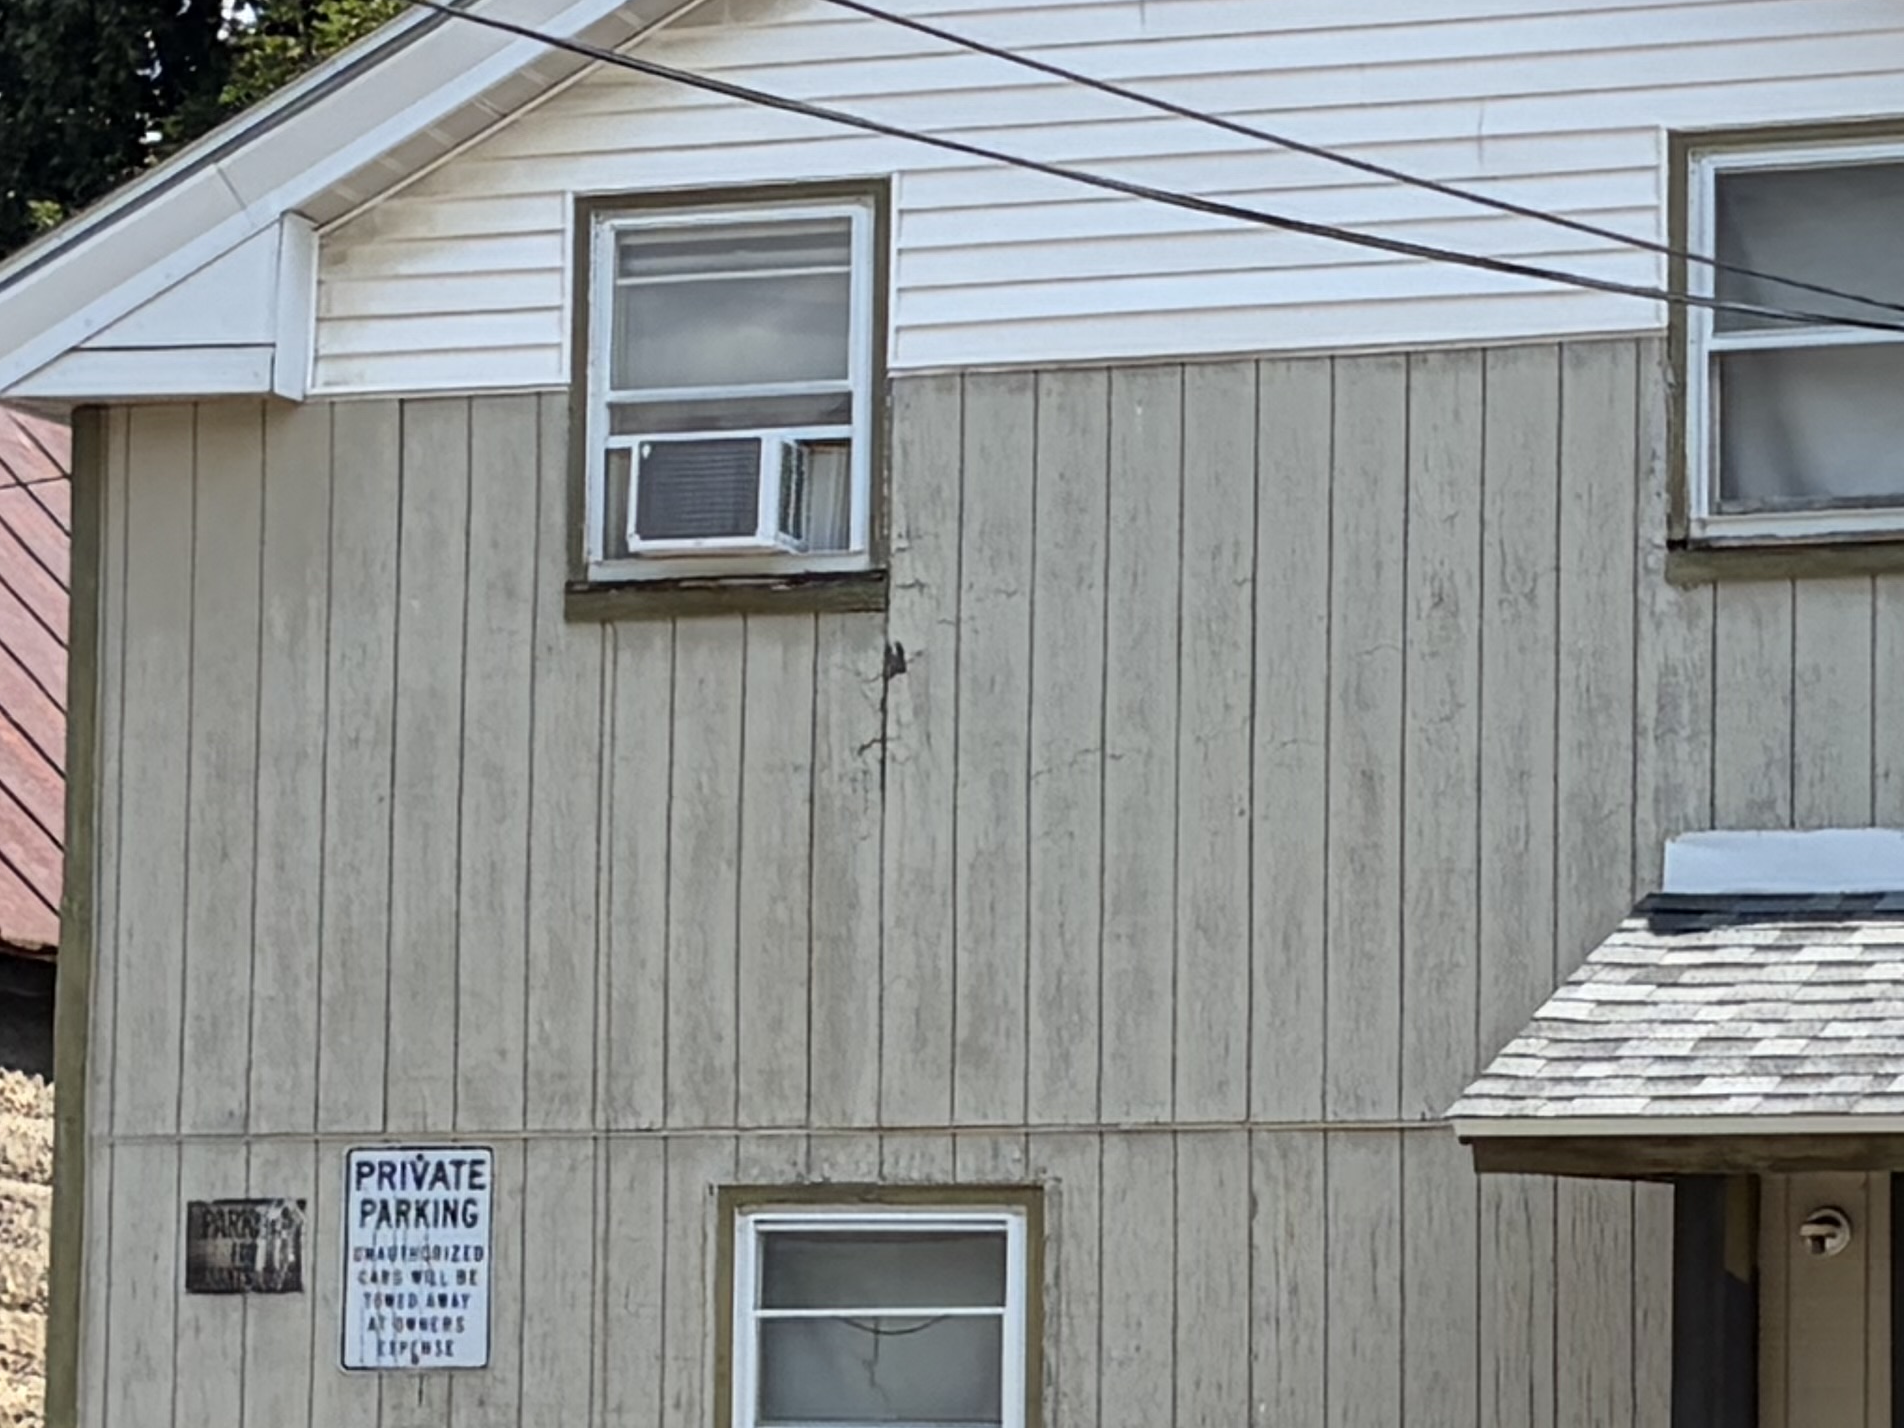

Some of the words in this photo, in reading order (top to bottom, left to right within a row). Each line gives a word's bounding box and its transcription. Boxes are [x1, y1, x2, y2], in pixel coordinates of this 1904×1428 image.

[355, 1159, 487, 1192] PRIVATE
[359, 1199, 479, 1230] PARKING
[352, 1244, 484, 1263] UNAUTHORIZED
[357, 1269, 403, 1286] CARS
[411, 1269, 448, 1287] WILL
[456, 1269, 477, 1286] BE
[363, 1292, 418, 1309] TOWED
[426, 1292, 470, 1309] AWAY
[367, 1315, 386, 1332] AT
[377, 1339, 454, 1358] EXPENSE
